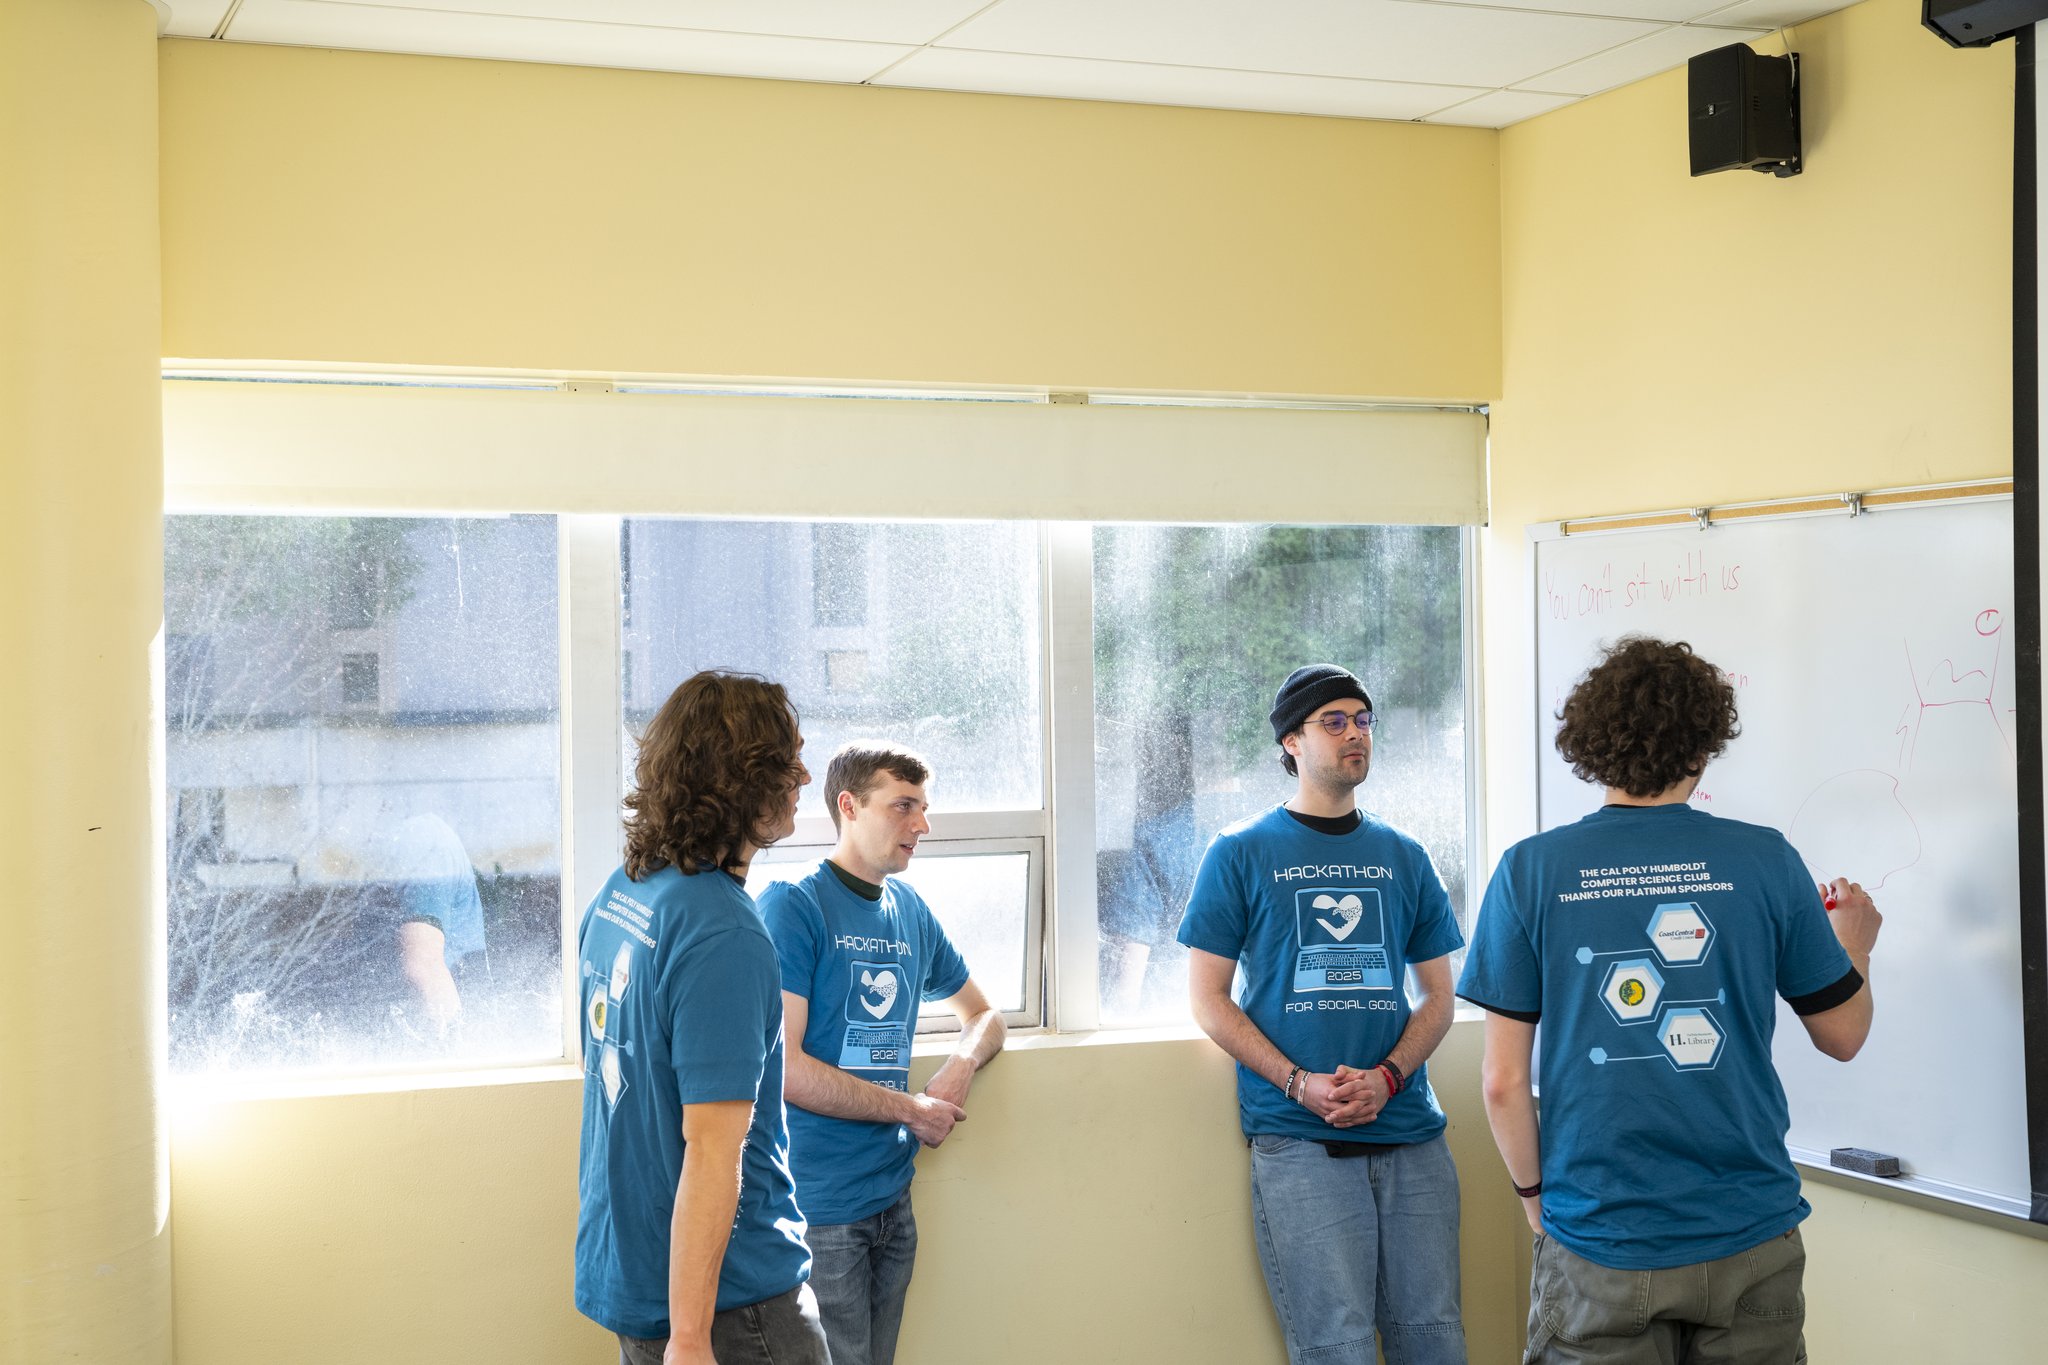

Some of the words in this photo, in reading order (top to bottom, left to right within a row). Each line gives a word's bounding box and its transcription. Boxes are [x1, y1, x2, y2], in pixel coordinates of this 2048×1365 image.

[1545, 568, 1570, 620] You
[1577, 562, 1613, 616] can't
[1624, 561, 1652, 607] sit
[1660, 548, 1708, 602] with
[1721, 565, 1741, 591] us
[1273, 864, 1394, 883] HACKATHON
[1579, 868, 1600, 878] THE
[1600, 867, 1622, 877] CAL
[1622, 865, 1649, 875] POLY
[1650, 862, 1707, 874] HUMBOLDT
[1580, 877, 1638, 889] COMPUTER
[1638, 874, 1683, 885] SCIENCE
[1683, 872, 1711, 882] CLUB
[1558, 890, 1601, 903] THANKS
[1601, 888, 1625, 898] OUR
[1625, 885, 1678, 897] PLATINUM
[1678, 882, 1735, 894] SPONSORS
[834, 934, 913, 957] HACKATHON
[1327, 971, 1362, 981] 2025
[1285, 1001, 1314, 1013] FOR
[1317, 999, 1367, 1011] SOCIAL
[1368, 1000, 1398, 1011] GOOD
[1687, 1036, 1716, 1046] Library
[871, 1049, 898, 1060] 2025
